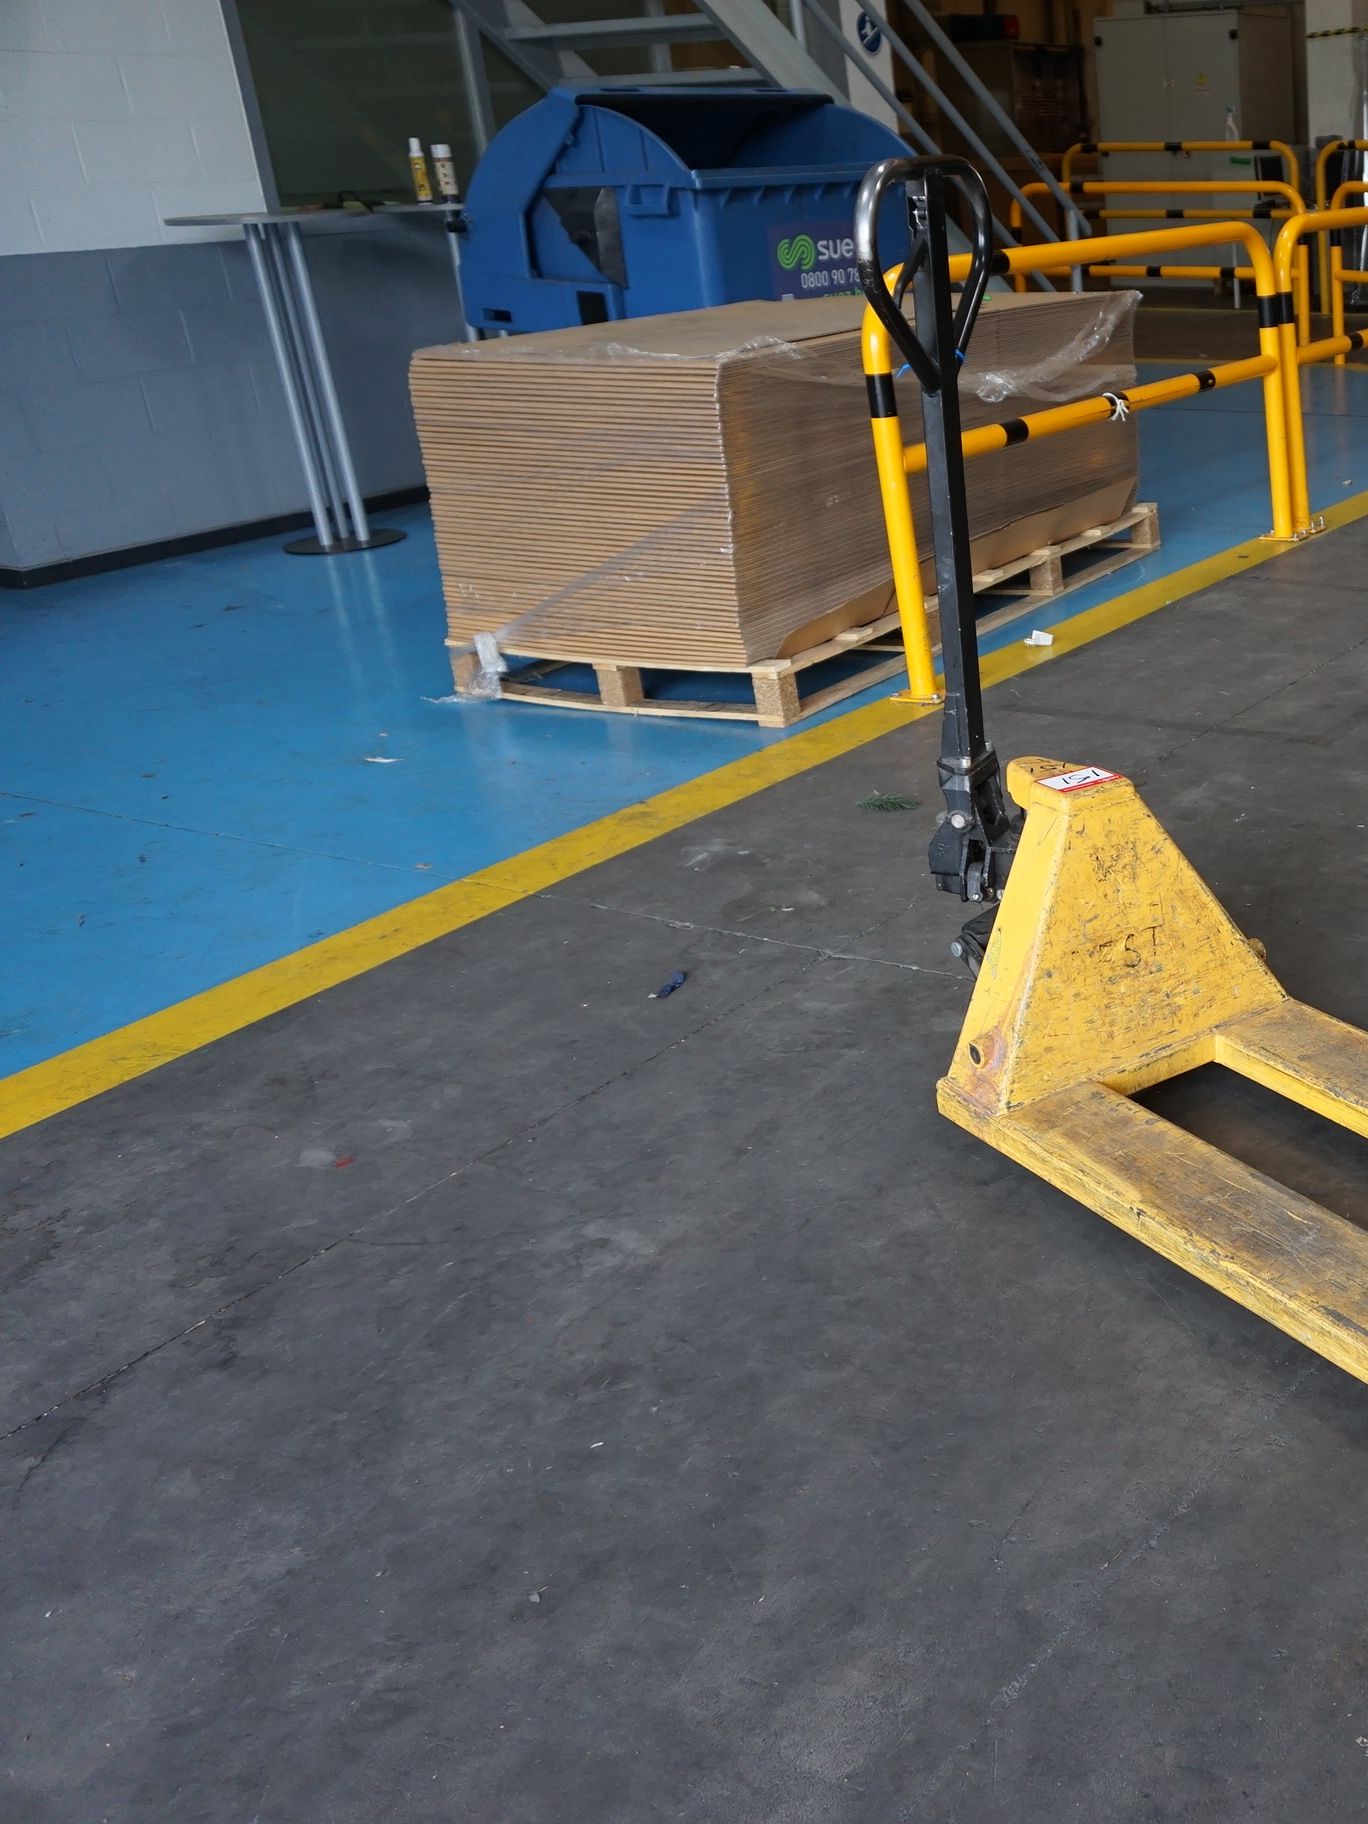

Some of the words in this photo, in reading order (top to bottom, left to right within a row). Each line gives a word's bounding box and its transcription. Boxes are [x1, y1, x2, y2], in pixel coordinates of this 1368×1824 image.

[816, 238, 855, 260] sue
[800, 270, 830, 289] 0800
[831, 268, 846, 286] 90
